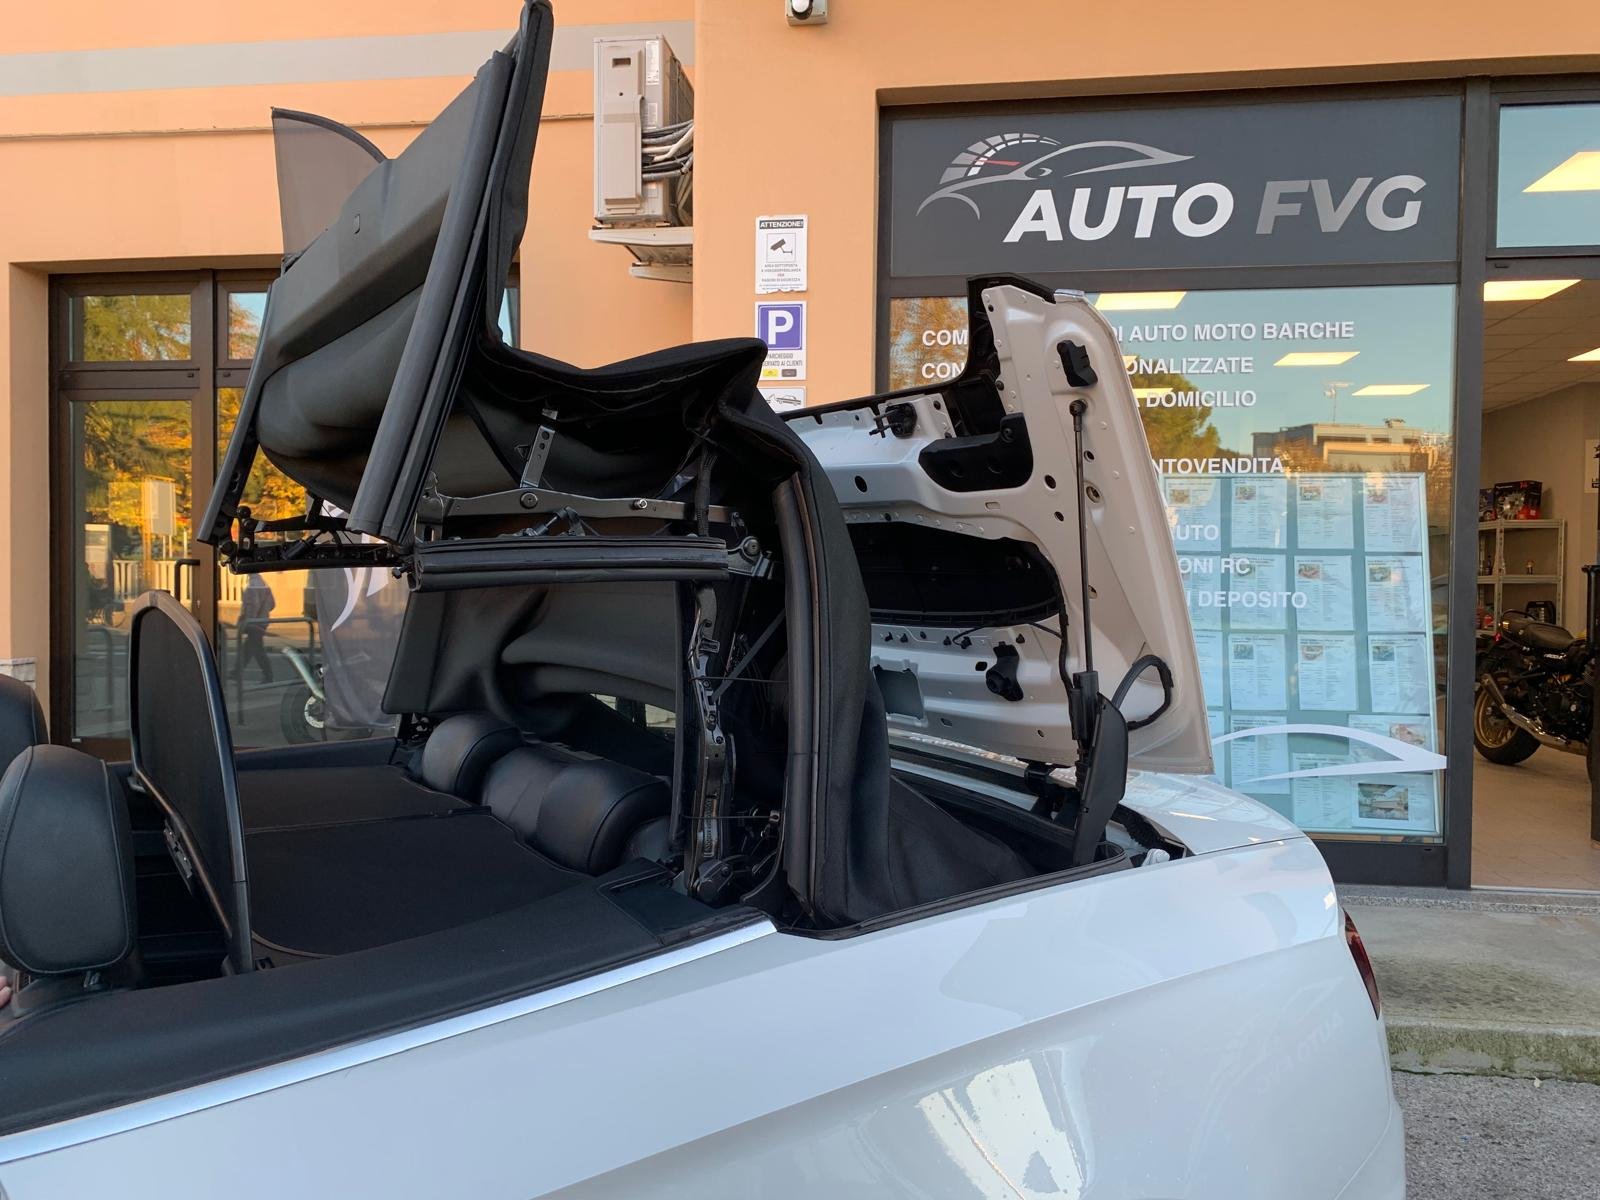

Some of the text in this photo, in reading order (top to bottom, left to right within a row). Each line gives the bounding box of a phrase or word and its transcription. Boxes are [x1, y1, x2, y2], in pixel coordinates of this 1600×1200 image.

[1003, 174, 1427, 243] AUTO FVG
[760, 220, 804, 228] ATTENZIONE!
[768, 310, 794, 345] P
[1129, 324, 1188, 341] AUTO
[1194, 323, 1257, 340] MOTO
[1263, 321, 1355, 339] BARCHE
[1146, 390, 1257, 408] DOMICILIO
[1174, 524, 1219, 541] UTO
[1221, 558, 1251, 574] RC
[1198, 590, 1308, 609] DEPOSITO
